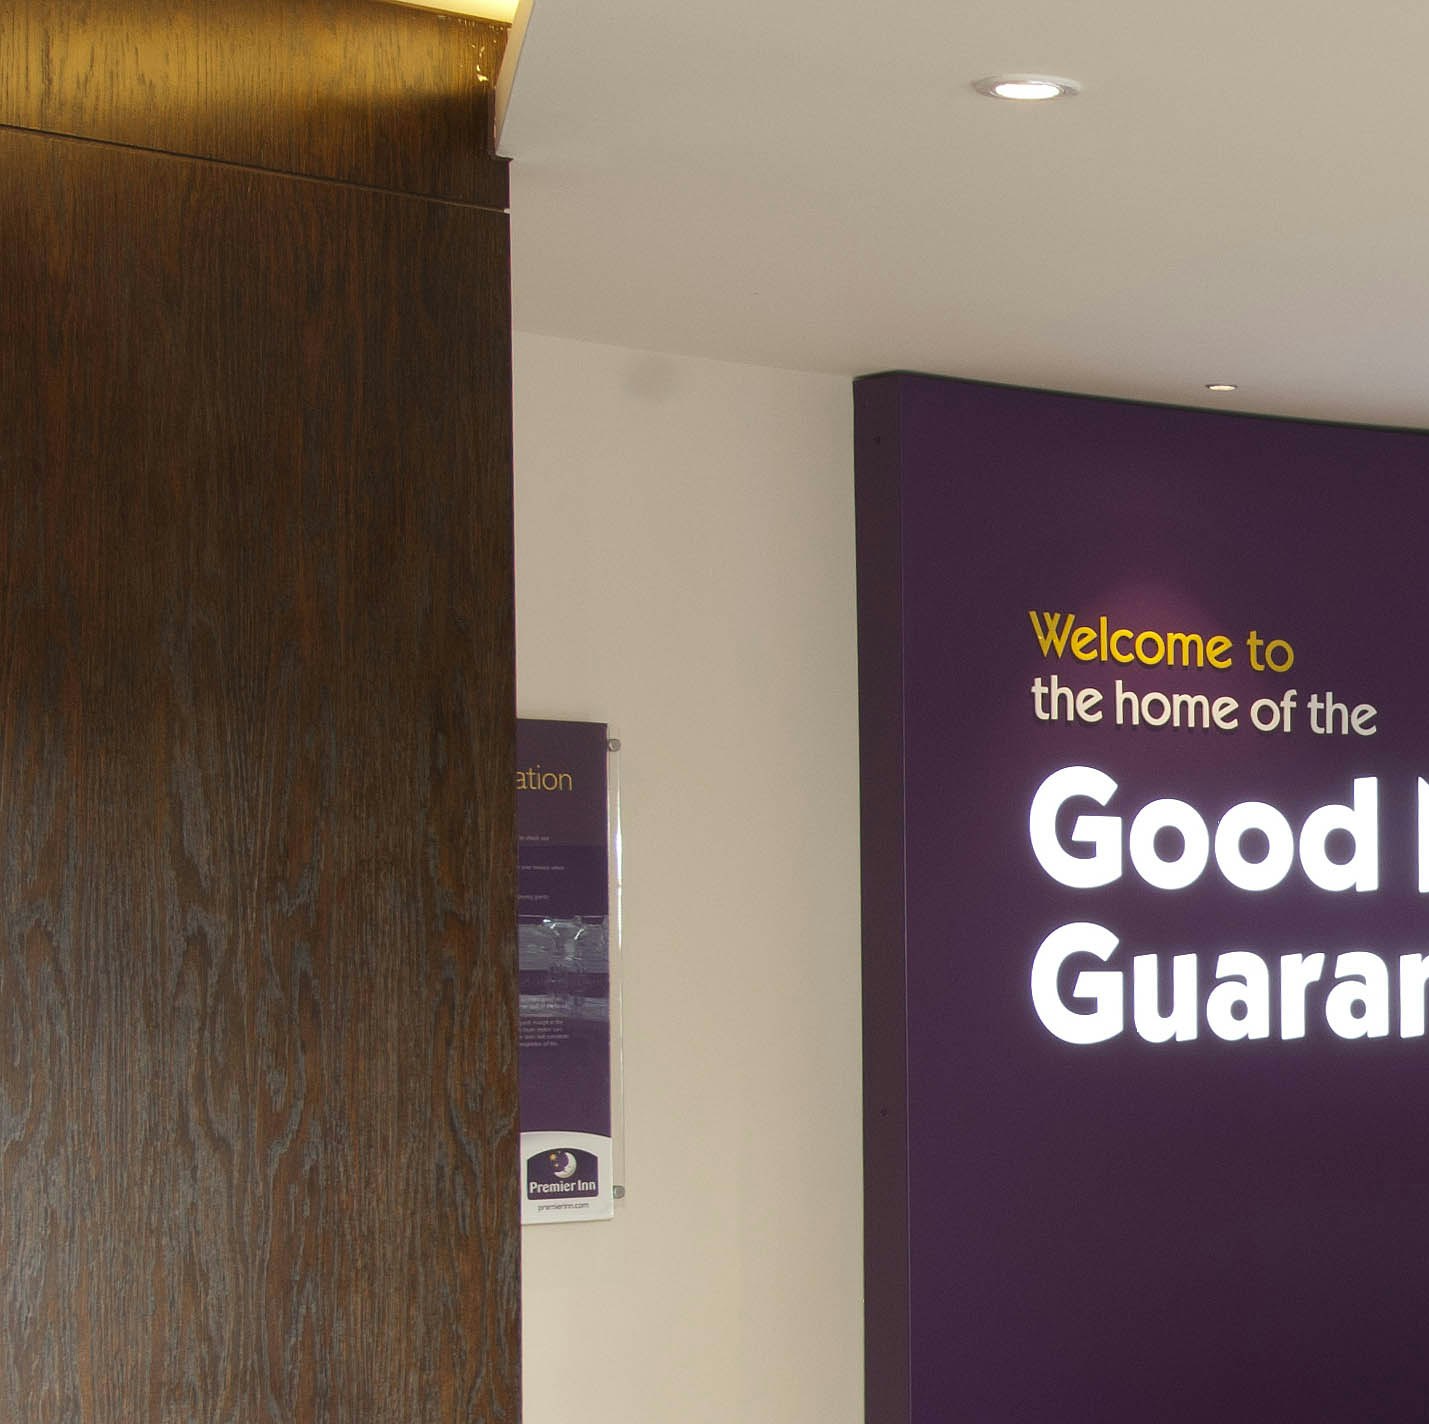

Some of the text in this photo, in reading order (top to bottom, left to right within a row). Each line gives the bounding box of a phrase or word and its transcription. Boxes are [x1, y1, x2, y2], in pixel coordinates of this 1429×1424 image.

[1029, 611, 1294, 673] Welcome to
[1032, 675, 1377, 736] the home of the
[1029, 766, 1379, 891] Good
[529, 1180, 596, 1193] Premier Inn
